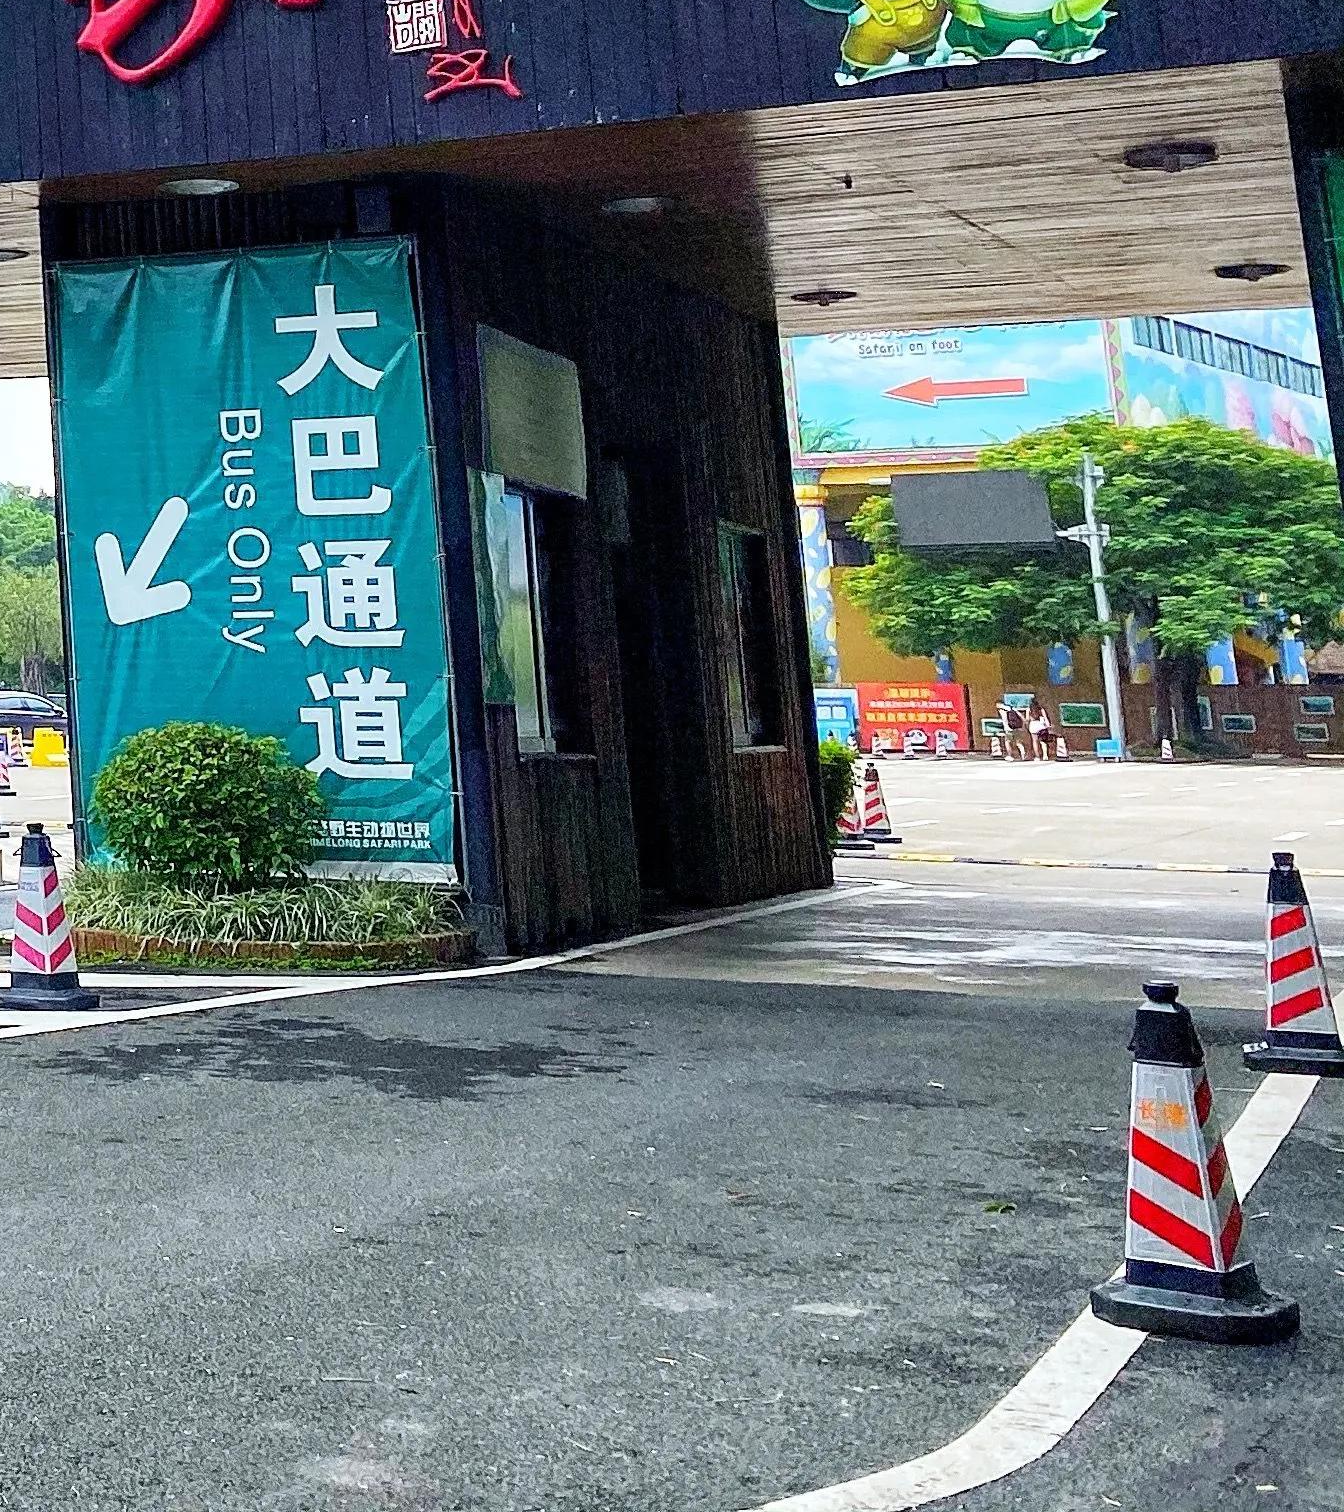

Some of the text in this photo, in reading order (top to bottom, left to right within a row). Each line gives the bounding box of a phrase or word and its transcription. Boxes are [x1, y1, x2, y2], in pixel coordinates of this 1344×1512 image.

[858, 344, 902, 356] Safari
[909, 342, 925, 353] on
[218, 407, 272, 654] Bus Only
[274, 285, 414, 782] 大巴通道
[362, 839, 401, 849] SAFARI
[403, 839, 431, 849] PARK
